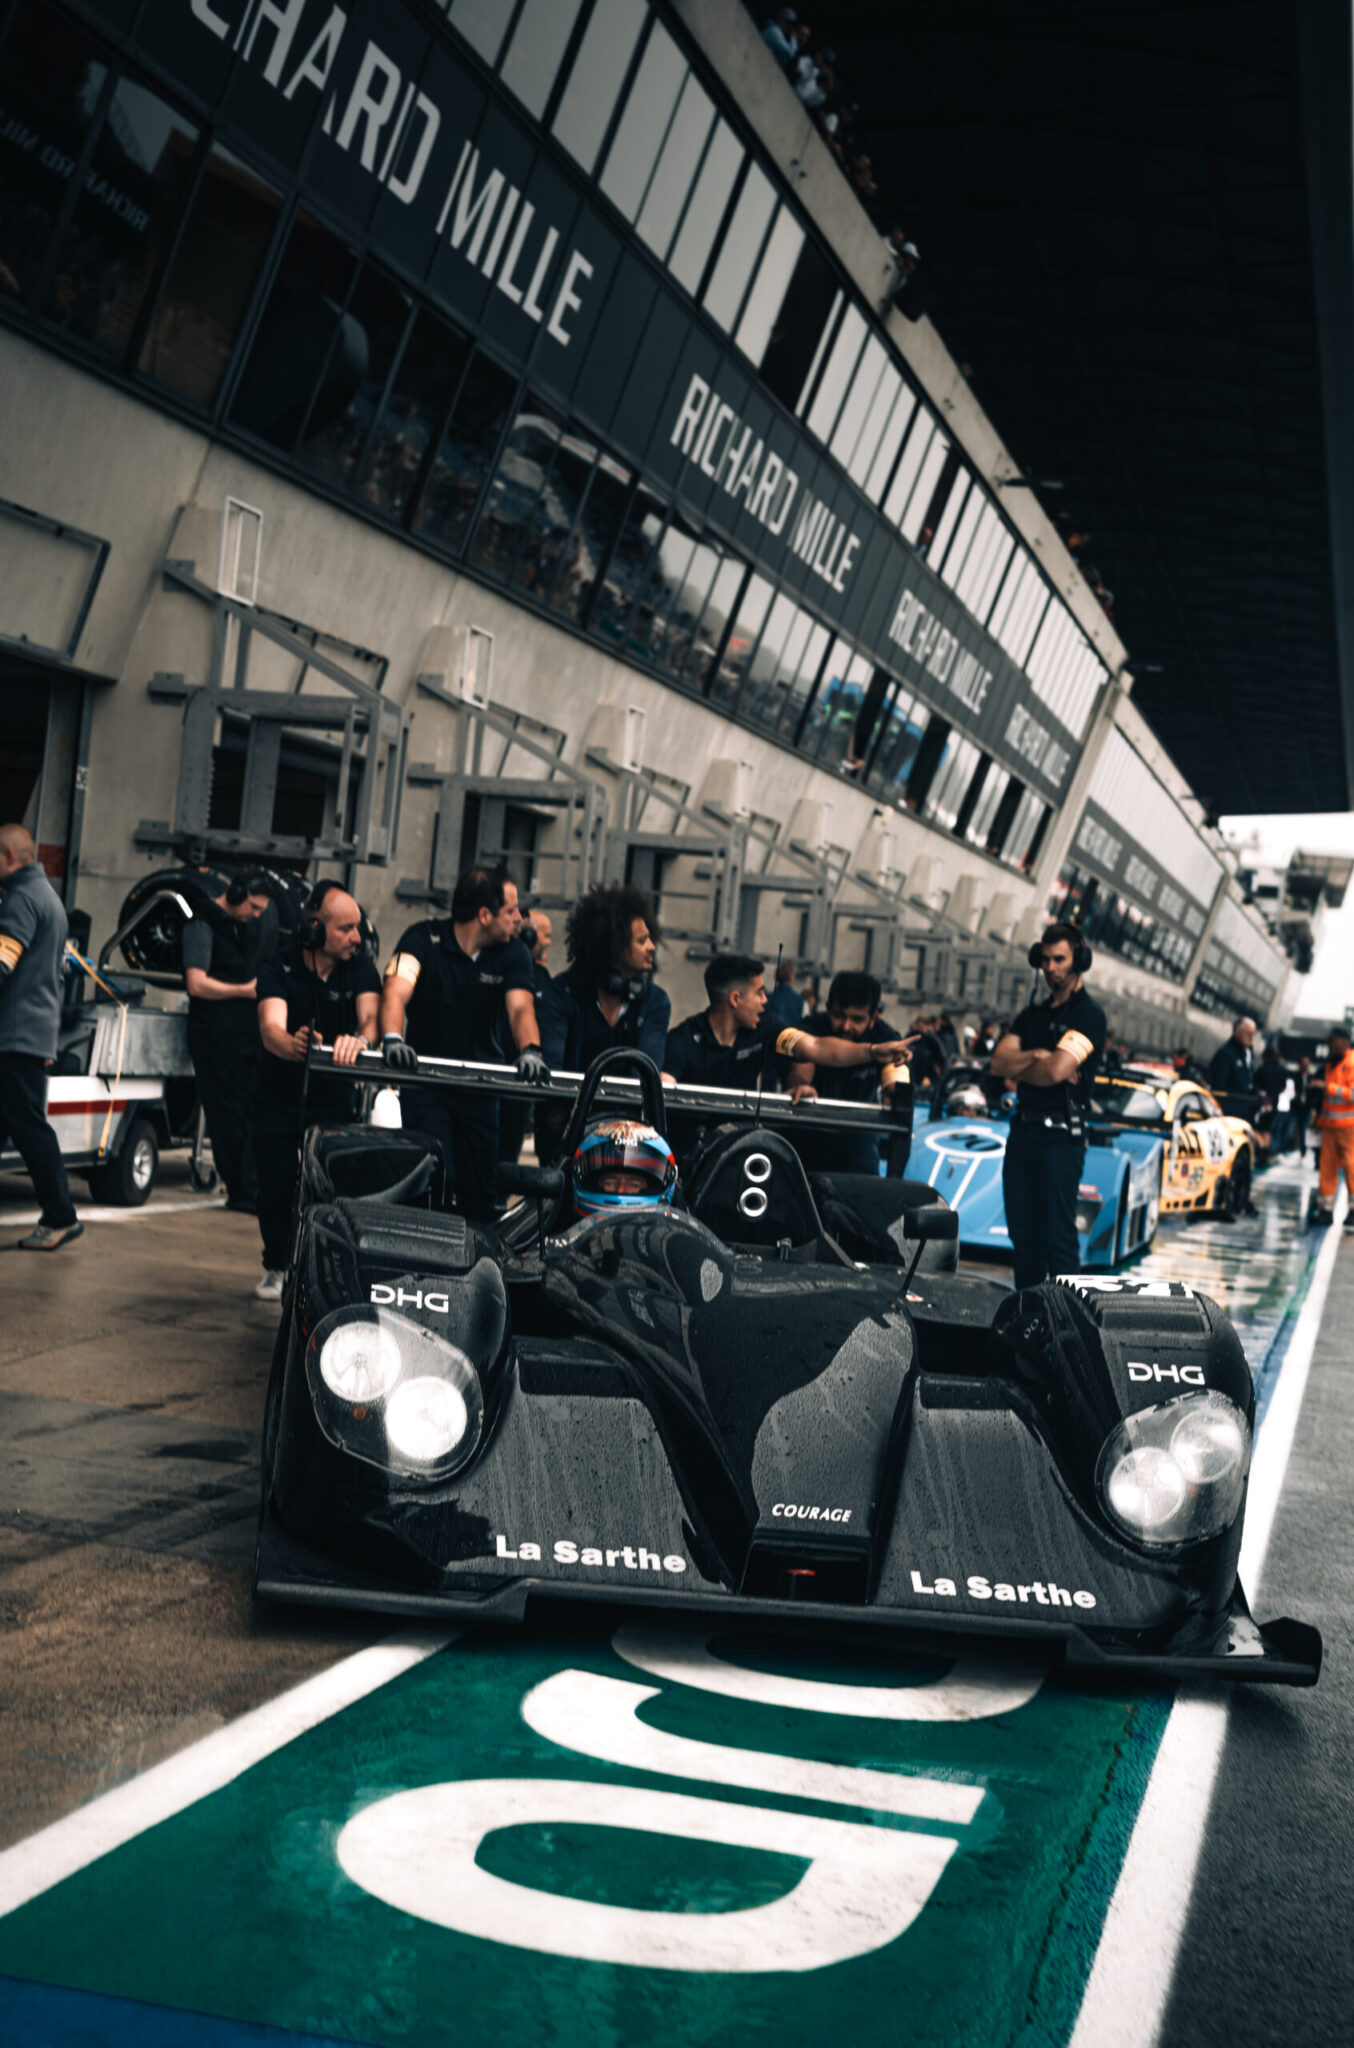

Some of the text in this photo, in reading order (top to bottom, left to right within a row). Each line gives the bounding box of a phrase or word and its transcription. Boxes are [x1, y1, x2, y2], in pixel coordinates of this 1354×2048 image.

[436, 138, 595, 347] MILLE
[670, 372, 860, 594] RICHARD MILLE
[370, 1283, 449, 1314] DHG
[1127, 1361, 1206, 1386] DHG
[771, 1502, 853, 1524] COURAGE
[496, 1534, 687, 1574] La Sarthe
[910, 1570, 1098, 1609] La Sarthe
